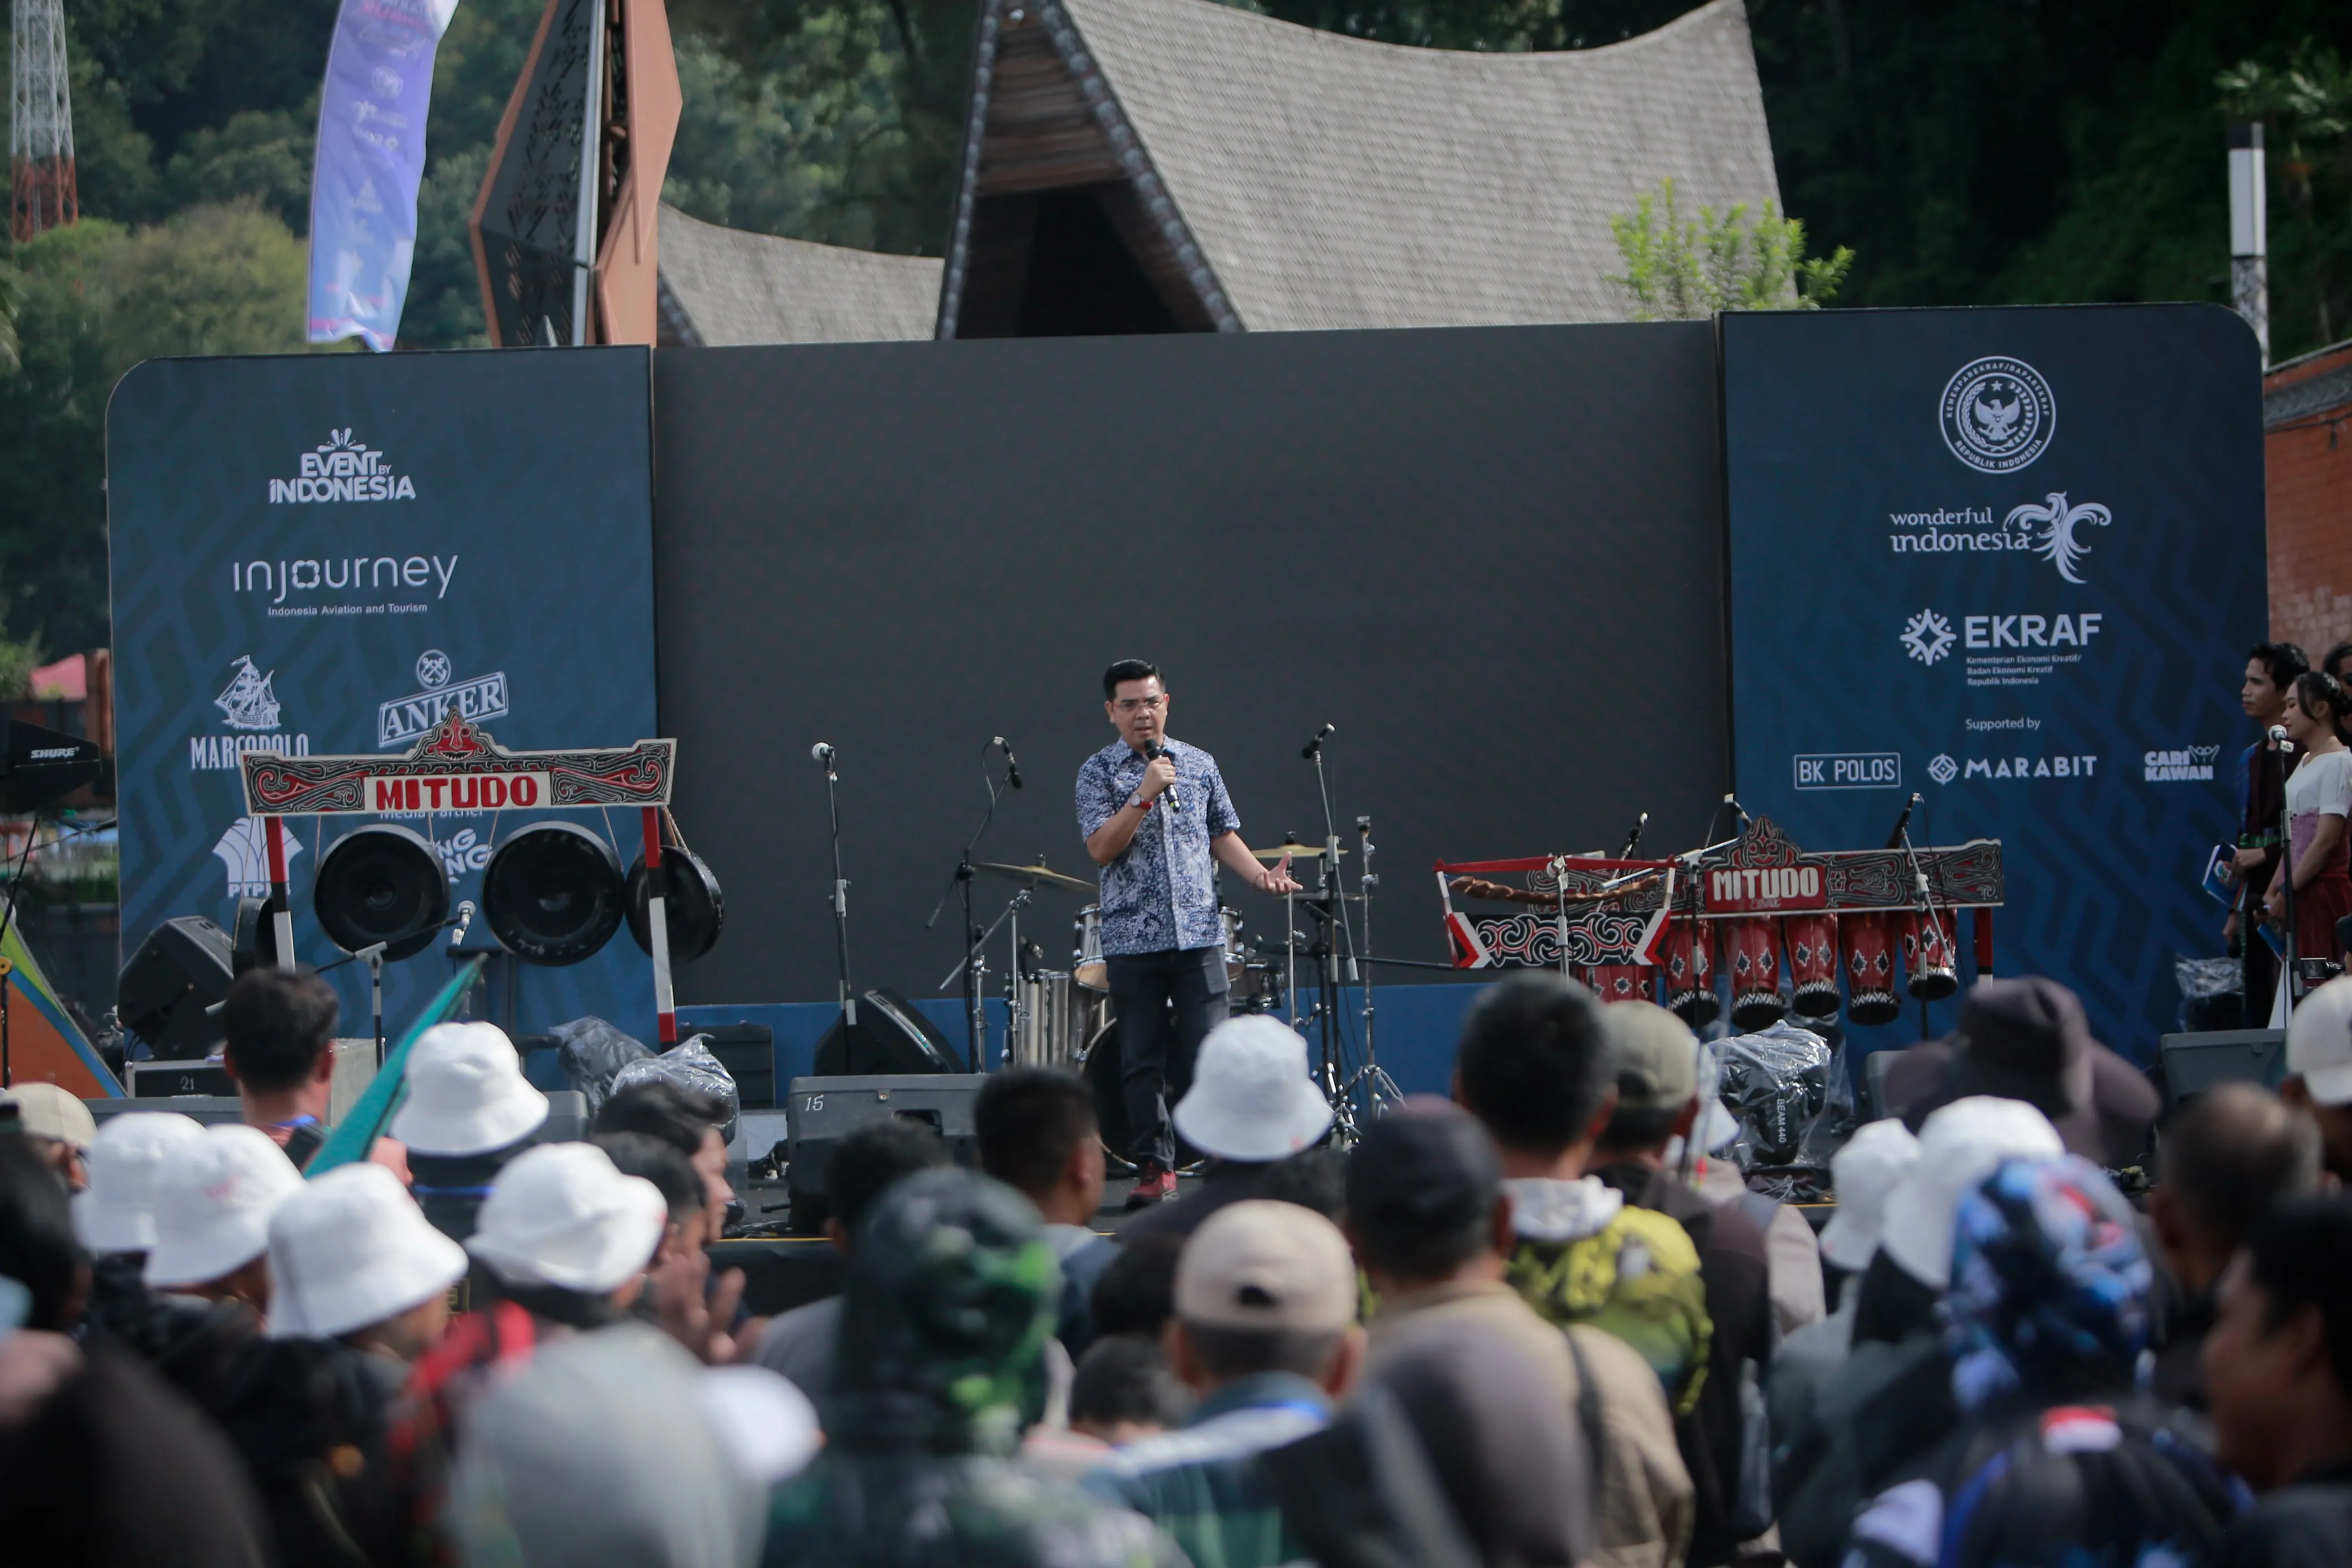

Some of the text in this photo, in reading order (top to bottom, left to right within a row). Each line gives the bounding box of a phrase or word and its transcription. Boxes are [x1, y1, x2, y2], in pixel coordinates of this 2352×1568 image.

[301, 451, 391, 477] EVENT BY
[1955, 439, 2043, 469] REPUBLIK INDONESIA
[1889, 506, 1994, 526] wonderful
[1890, 526, 2033, 552] indonesia
[234, 555, 458, 603] injourney
[268, 603, 427, 617] Indonesia Aviation and Tourism
[1965, 613, 2102, 648] EKRAF
[1966, 654, 2081, 664] Kementerian Ekonomi Kreatif/
[1968, 676, 2039, 686] Republik Indonesia
[383, 681, 505, 738] ANKER
[1966, 717, 2040, 731] Supported by
[31, 747, 76, 759] SHURE
[2145, 750, 2190, 766] CARI
[1800, 759, 1895, 782] BK POLOS
[1964, 756, 2097, 779] MARABIT
[2145, 765, 2213, 782] KAWAN
[376, 775, 538, 810] MITUDO
[1713, 867, 1819, 901] MITUDO
[180, 1075, 194, 1090] 21
[805, 1094, 824, 1112] 15
[1776, 1098, 1785, 1125] BEAM
